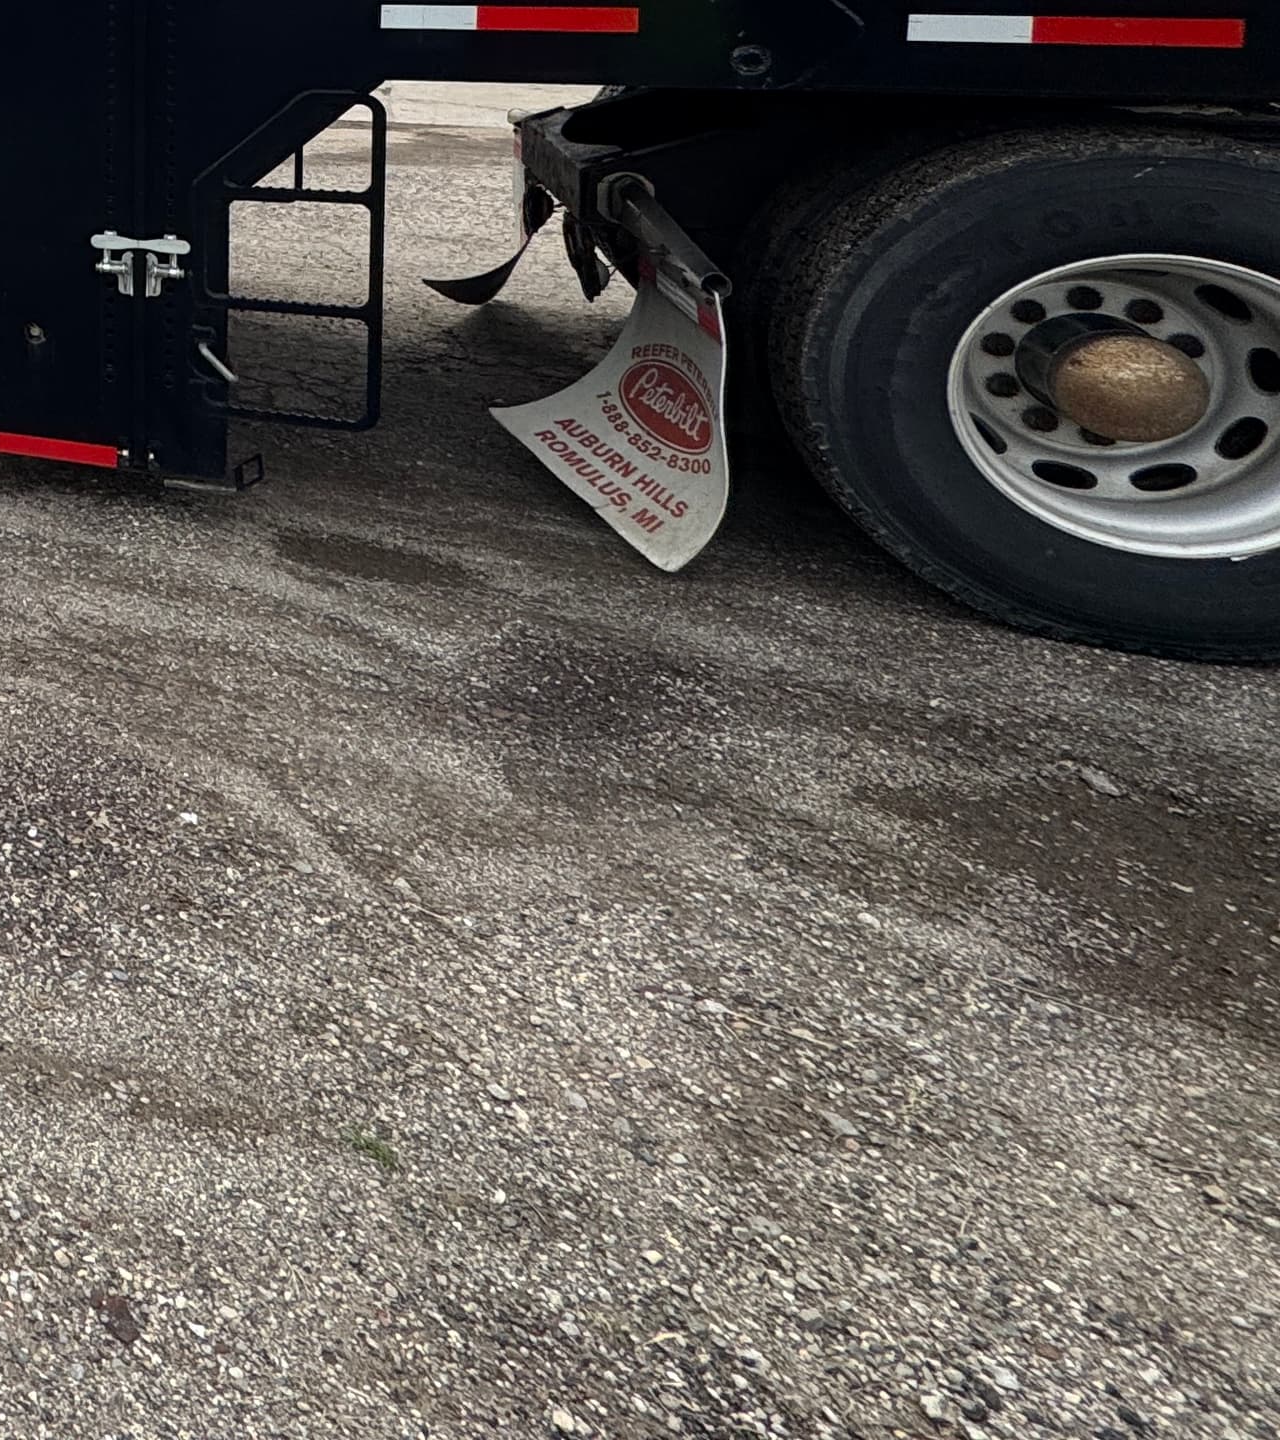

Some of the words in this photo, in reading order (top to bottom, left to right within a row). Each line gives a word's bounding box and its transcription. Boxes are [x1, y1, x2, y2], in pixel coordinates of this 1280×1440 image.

[631, 343, 680, 361] REEFER
[596, 391, 711, 475] 1-888-852-8300
[630, 367, 709, 441] Peterbilt
[534, 429, 633, 512] ROMULUS,
[631, 508, 666, 535] MI
[554, 417, 638, 478] AUBURN
[632, 474, 689, 518] HILLS
